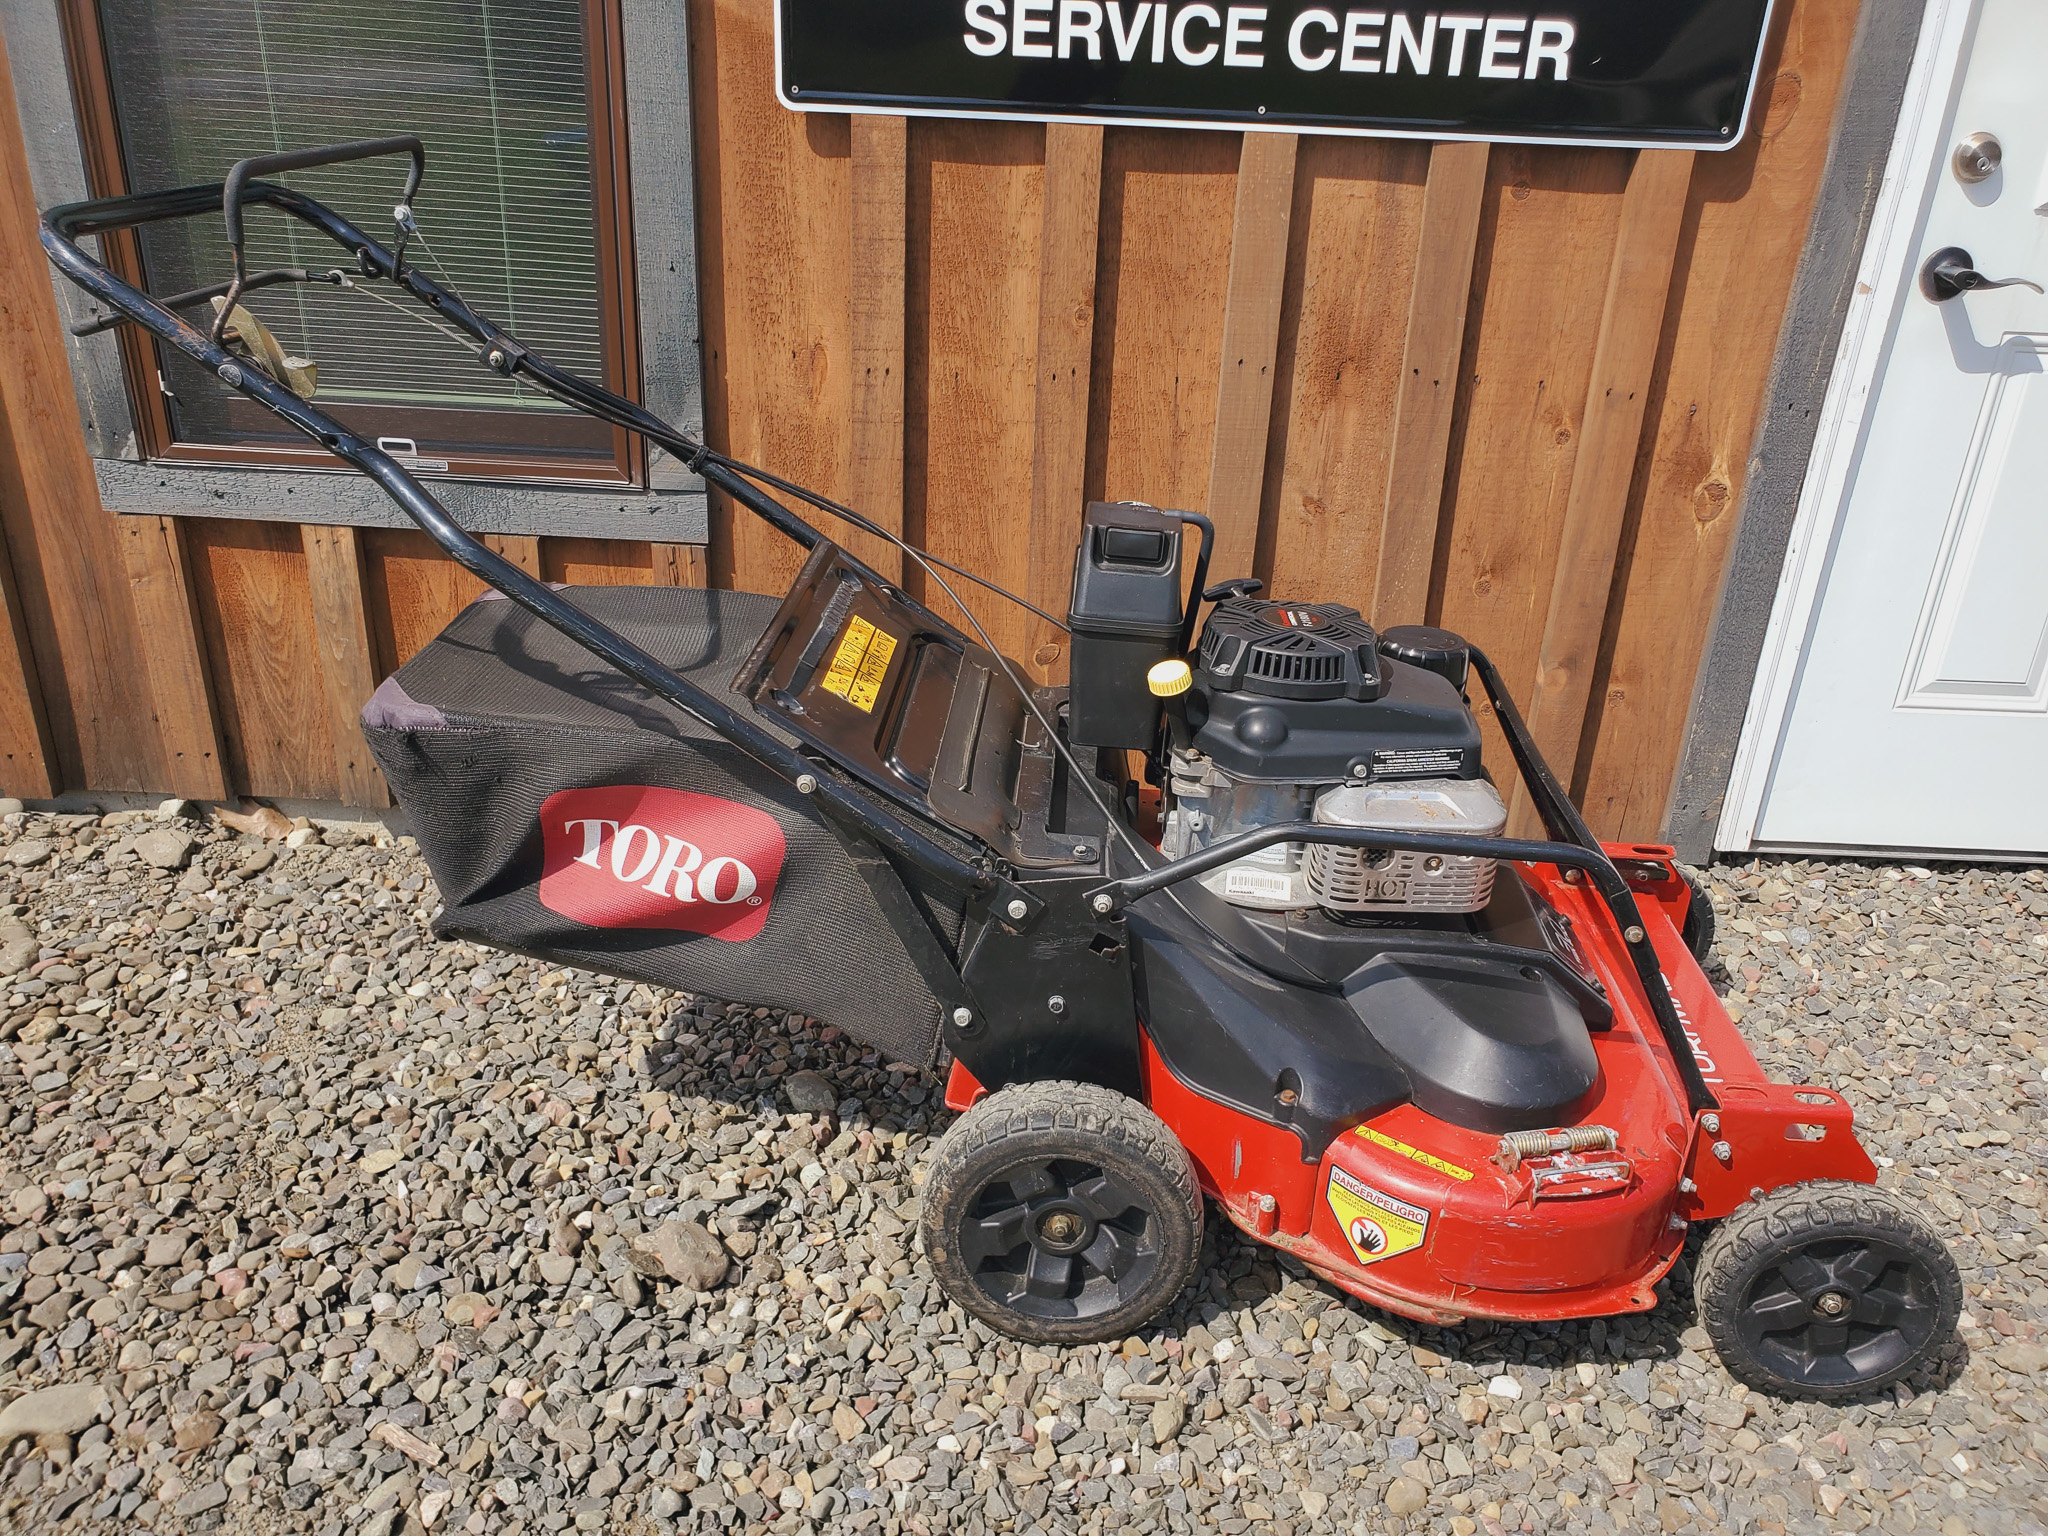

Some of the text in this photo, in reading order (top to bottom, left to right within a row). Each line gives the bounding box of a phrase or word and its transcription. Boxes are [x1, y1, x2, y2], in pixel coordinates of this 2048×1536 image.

[963, 0, 1575, 80] SERVICE CENTER
[565, 818, 758, 905] TORO
[1365, 879, 1413, 898] HOT
[1334, 1171, 1424, 1223] DANGER/PELIGRO
